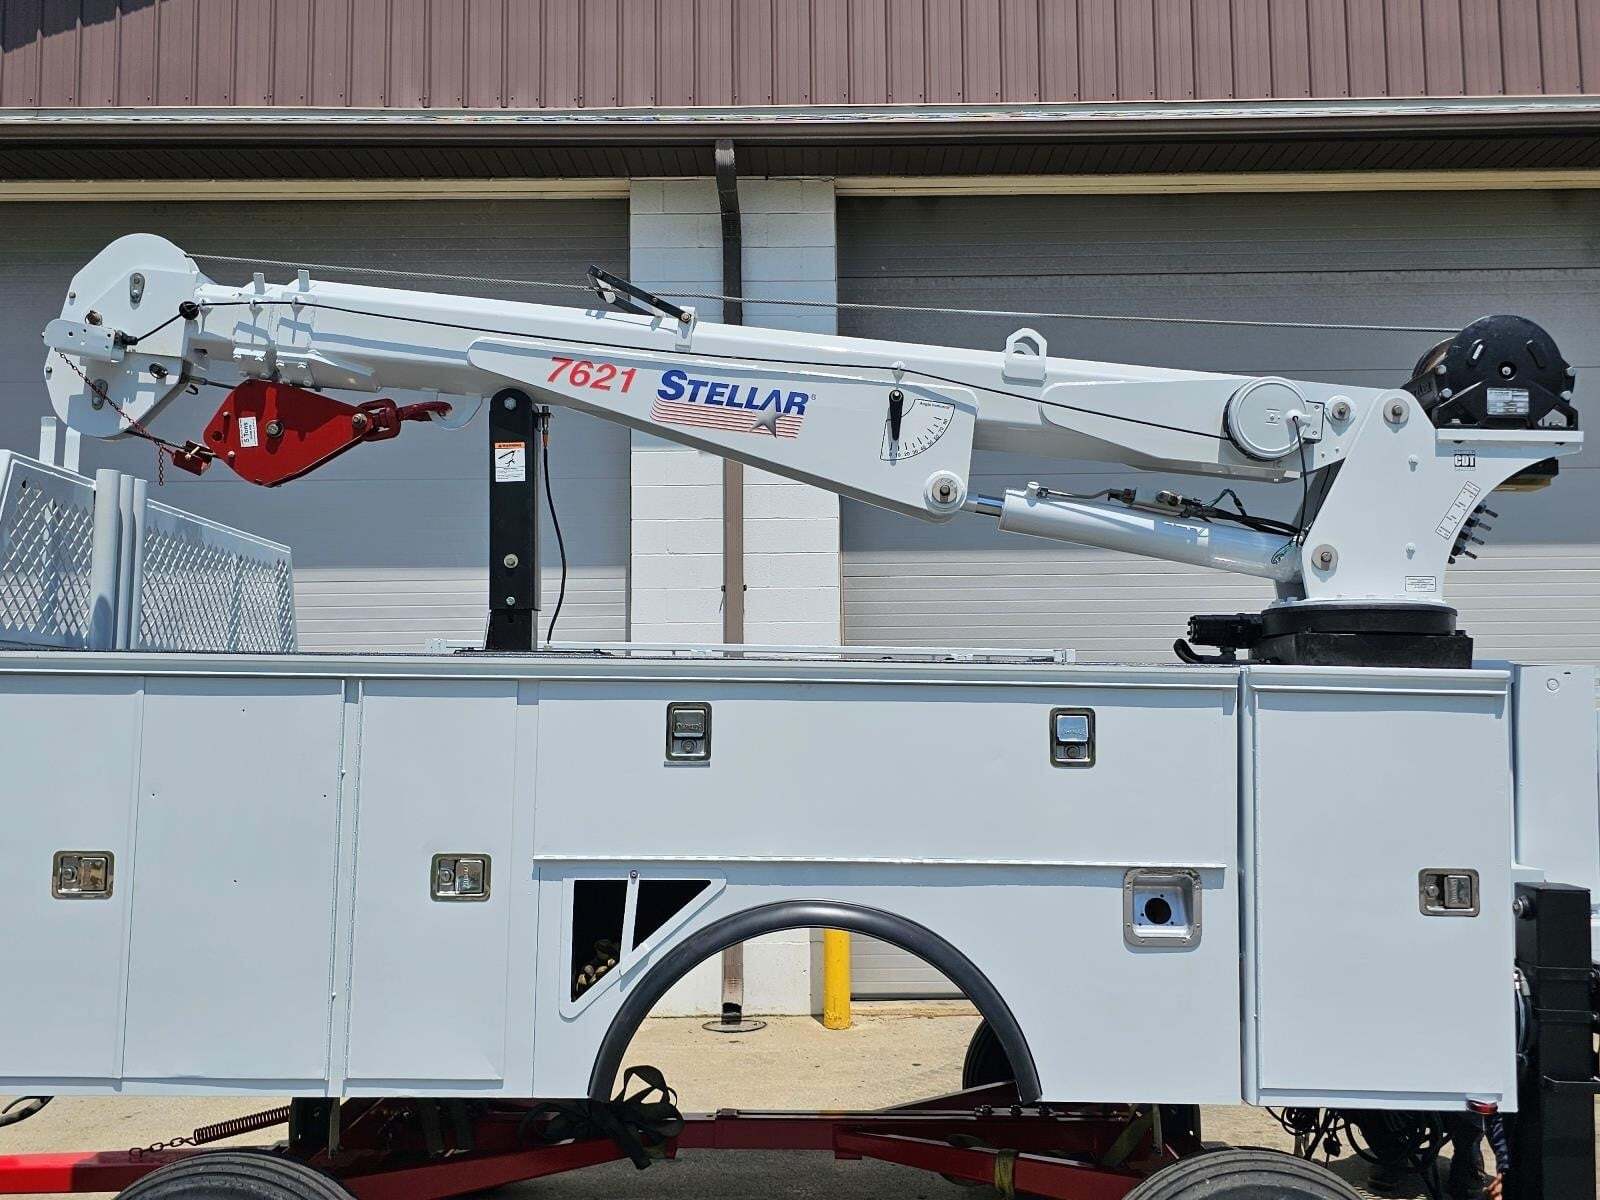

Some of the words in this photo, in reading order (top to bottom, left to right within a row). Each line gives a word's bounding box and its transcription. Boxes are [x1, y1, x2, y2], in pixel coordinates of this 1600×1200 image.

[547, 356, 637, 393] 7621
[657, 369, 809, 416] STELLAR
[1455, 454, 1475, 467] CDT
